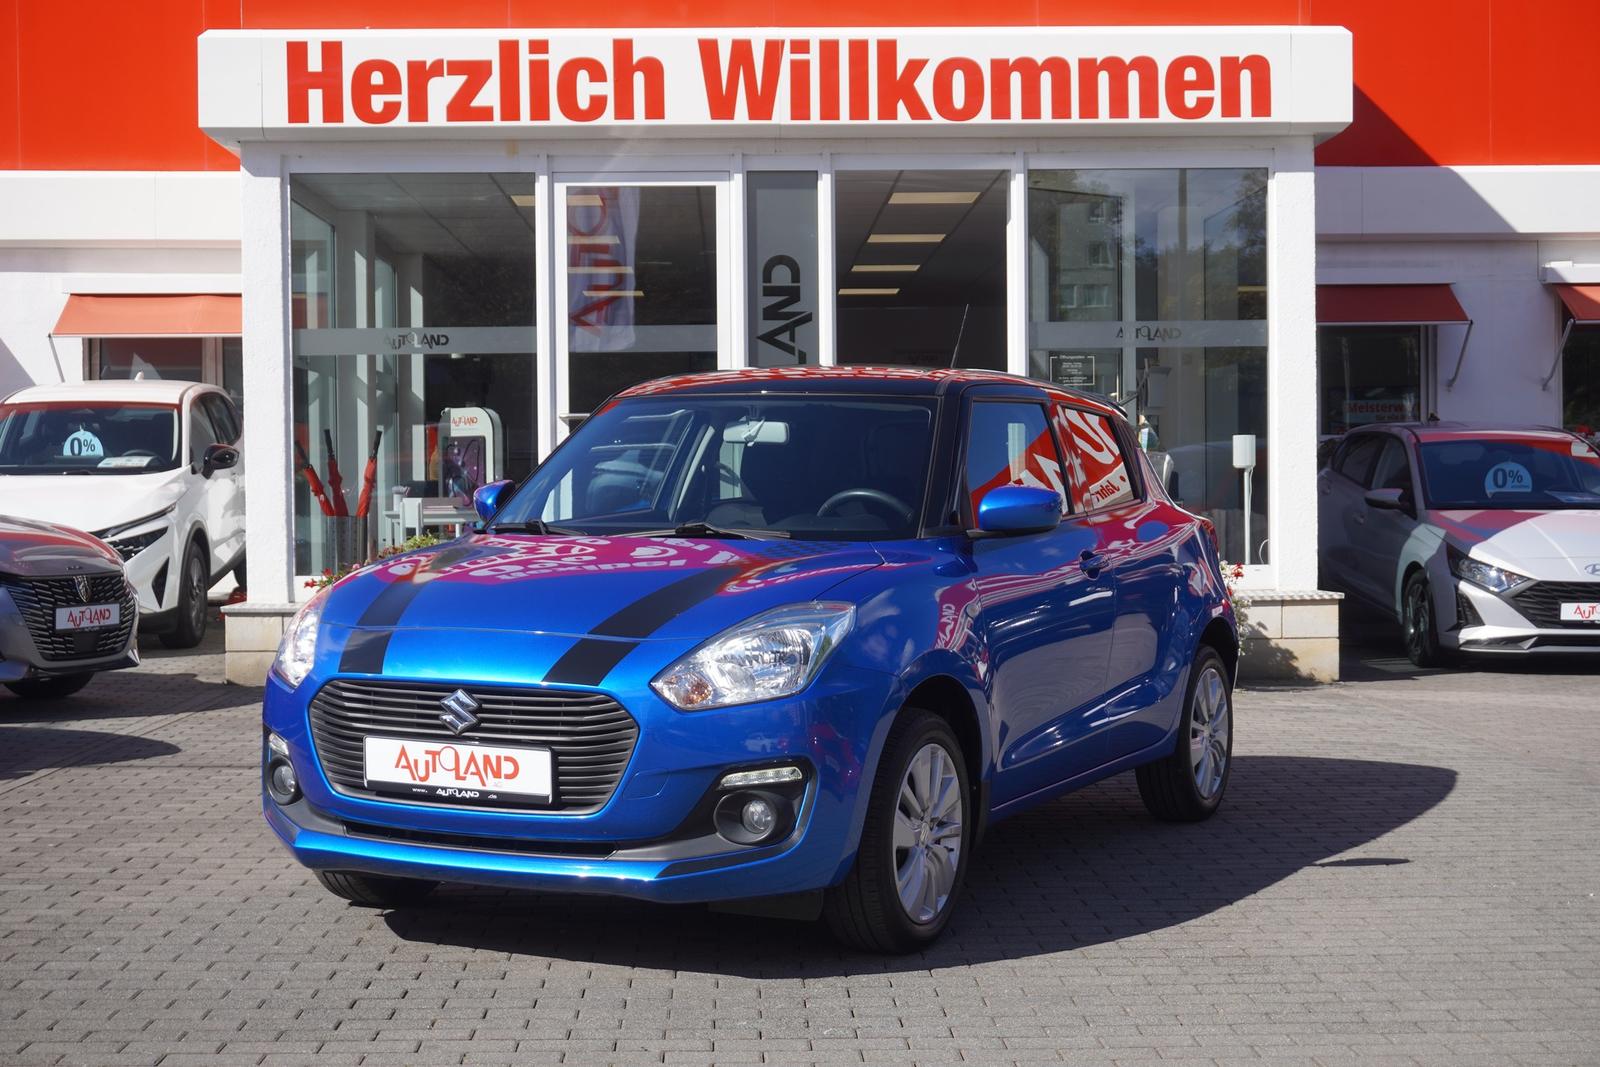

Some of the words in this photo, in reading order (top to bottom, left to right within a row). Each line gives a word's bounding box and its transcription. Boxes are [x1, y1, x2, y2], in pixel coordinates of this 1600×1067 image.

[286, 39, 665, 125] Herzlich
[698, 38, 1272, 122] Willkommen
[756, 254, 812, 364] AND
[69, 437, 96, 456] 0%
[1493, 468, 1524, 488] 0%
[67, 607, 111, 627] AUTOLAND
[394, 744, 520, 787] AUTOLAND
[436, 787, 480, 799] AUTOLAND
